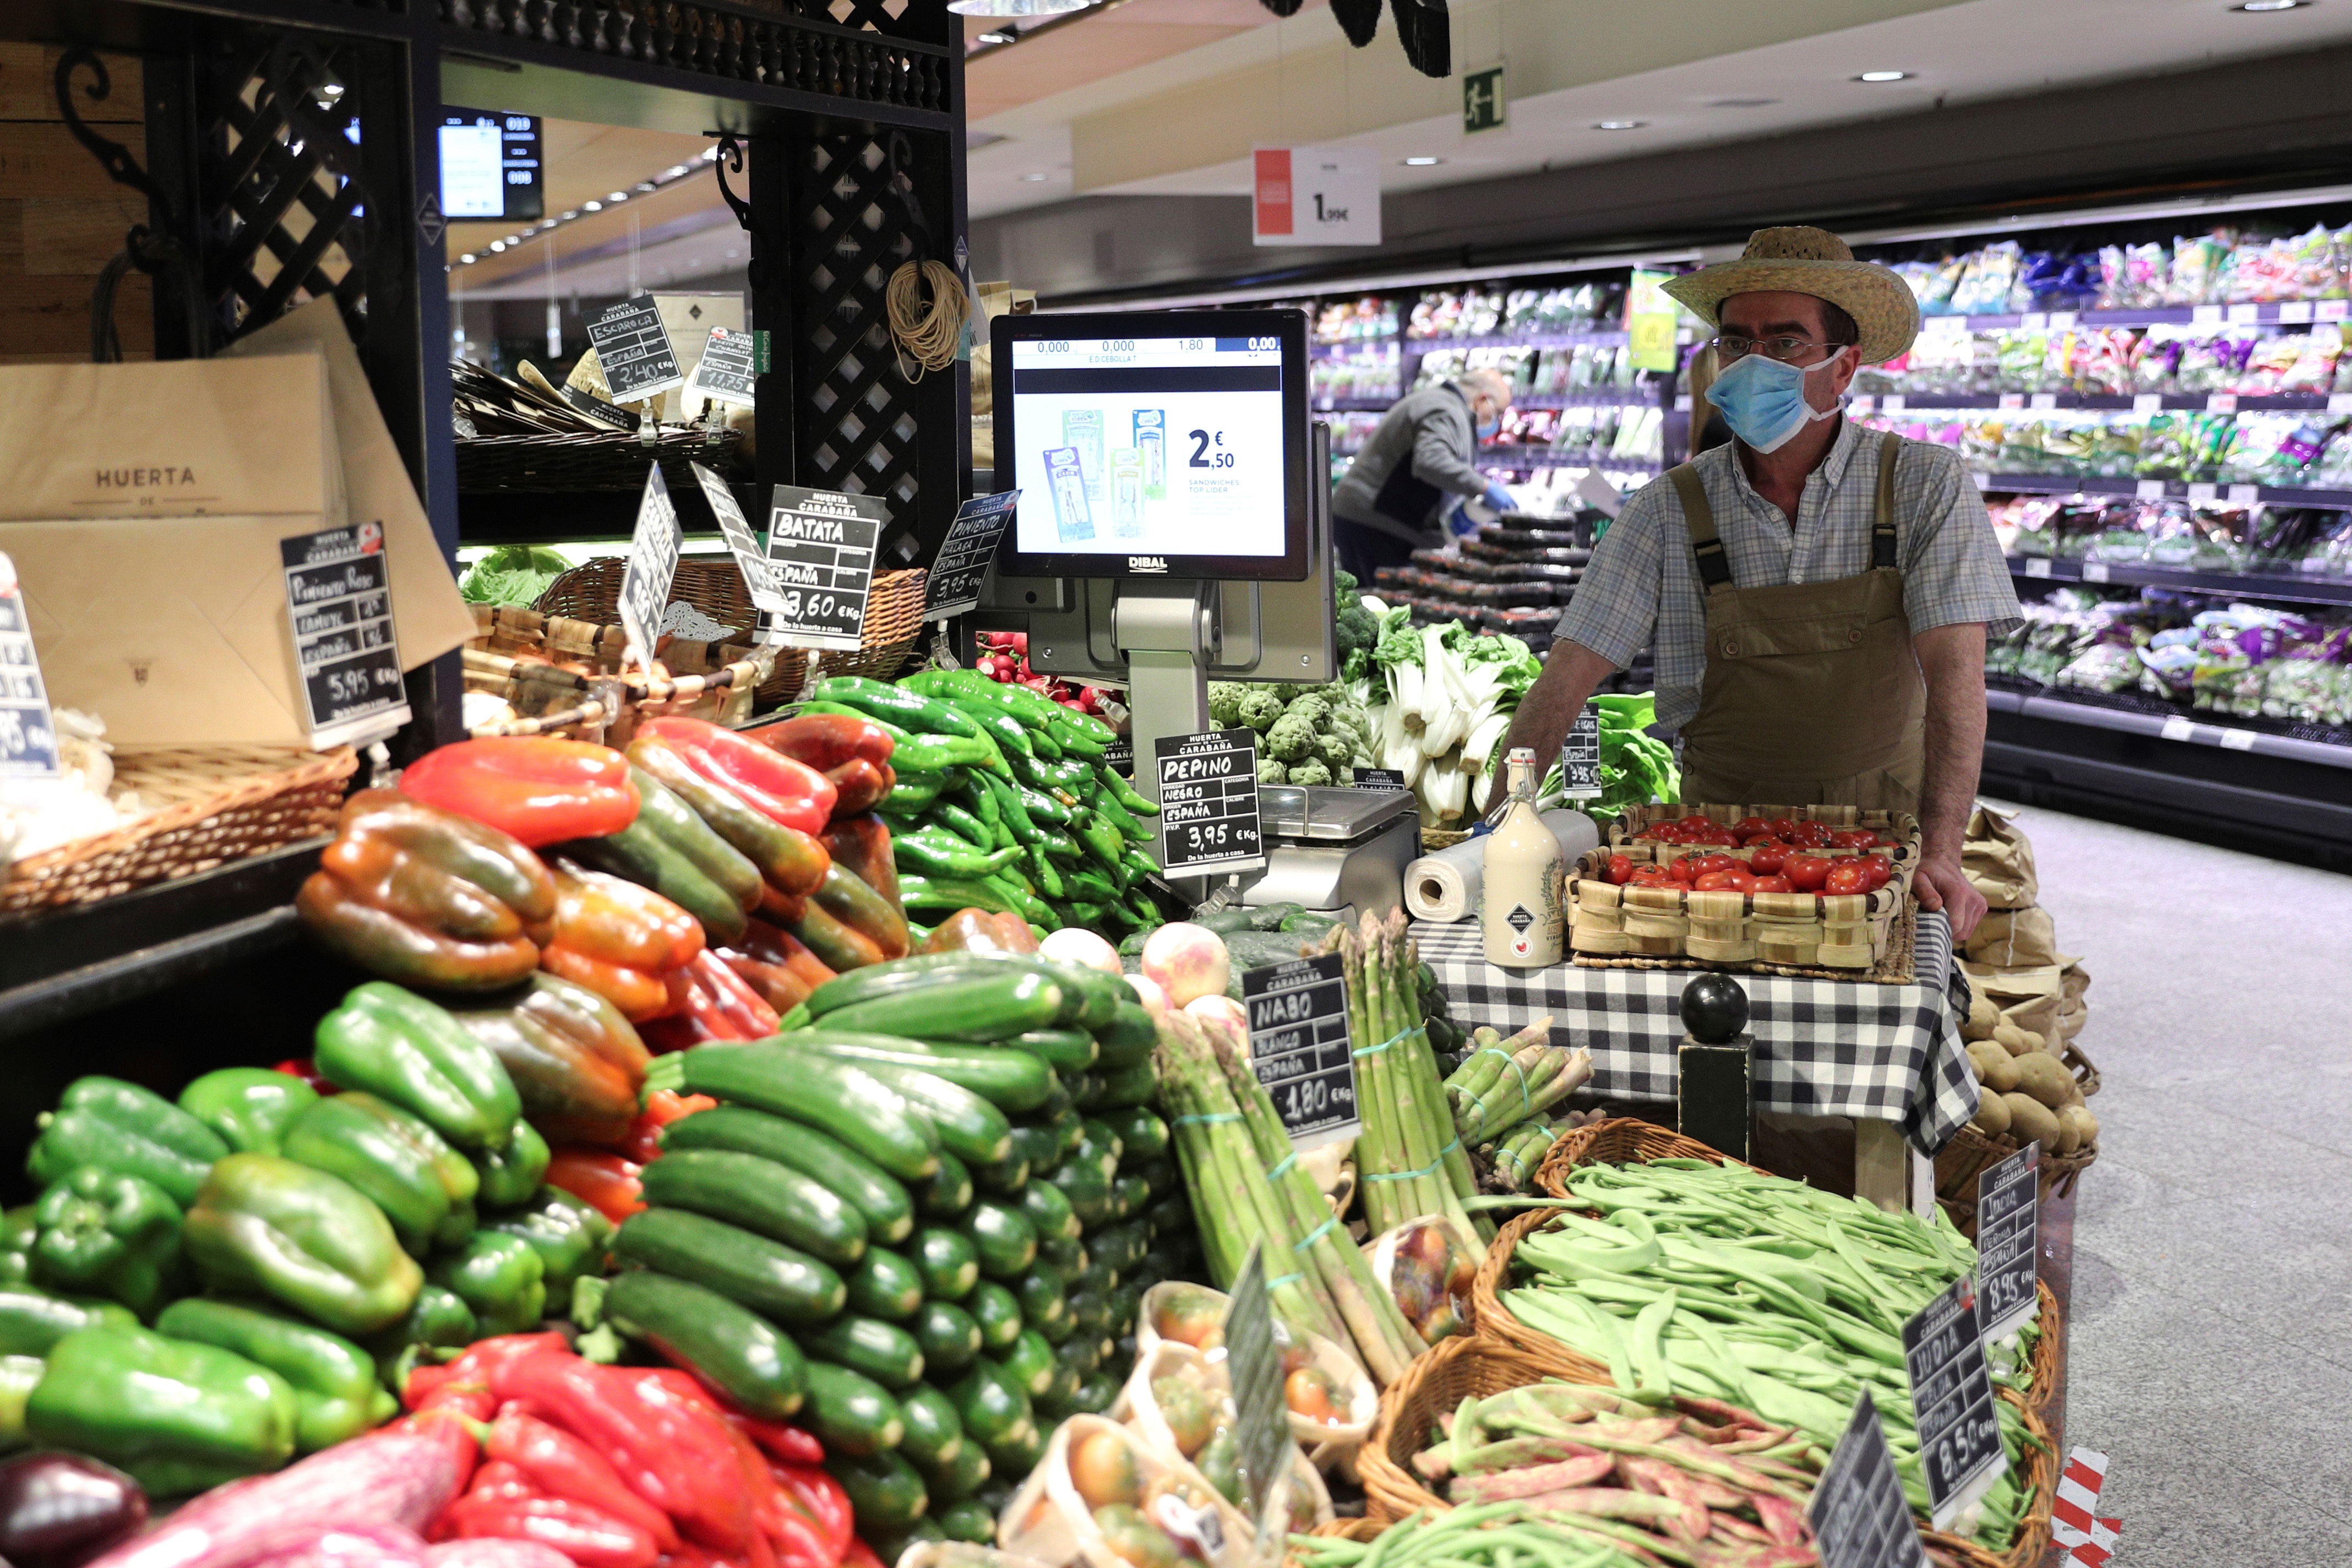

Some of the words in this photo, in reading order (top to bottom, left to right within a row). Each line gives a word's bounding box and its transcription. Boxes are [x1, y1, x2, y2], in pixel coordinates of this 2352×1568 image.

[606, 303, 629, 313] HUERTA
[594, 315, 652, 339] ESCAROLA
[1038, 341, 1069, 355] 0,000
[1103, 340, 1135, 354] 0,000
[1179, 339, 1203, 352] 1,80
[1248, 337, 1276, 353] 0,00
[590, 409, 628, 428] CARABAÑA
[601, 404, 624, 416] HUERTA
[96, 467, 195, 487] HUERTA
[140, 497, 154, 506] DE
[813, 493, 848, 504] HUERTA
[799, 503, 857, 517] CARABAÑA
[972, 503, 1004, 515] CARABAÑA
[776, 514, 843, 542] BATATA
[952, 515, 1000, 537] PIMIENTO
[937, 555, 965, 573] ESPAÑA
[1129, 556, 1167, 568] DIBAL
[771, 565, 818, 585] ESPAÑA
[937, 573, 969, 598] 3,95
[787, 590, 835, 622] 3,60
[800, 623, 820, 631] huerta
[1190, 733, 1221, 742] HUERTA
[1180, 742, 1232, 754] CARABAÑA
[1164, 756, 1232, 781] PEPINO
[1165, 787, 1202, 801] NEGRO
[1167, 802, 1210, 821] ESPAÑA
[1189, 824, 1228, 851] 3,95
[1256, 992, 1312, 1028] NABO
[2001, 1156, 2019, 1172] HUERTA
[1994, 1166, 2025, 1189] CARABAÑA
[1982, 1242, 2015, 1276] ESPAÑA
[2017, 1296, 2026, 1305] casa
